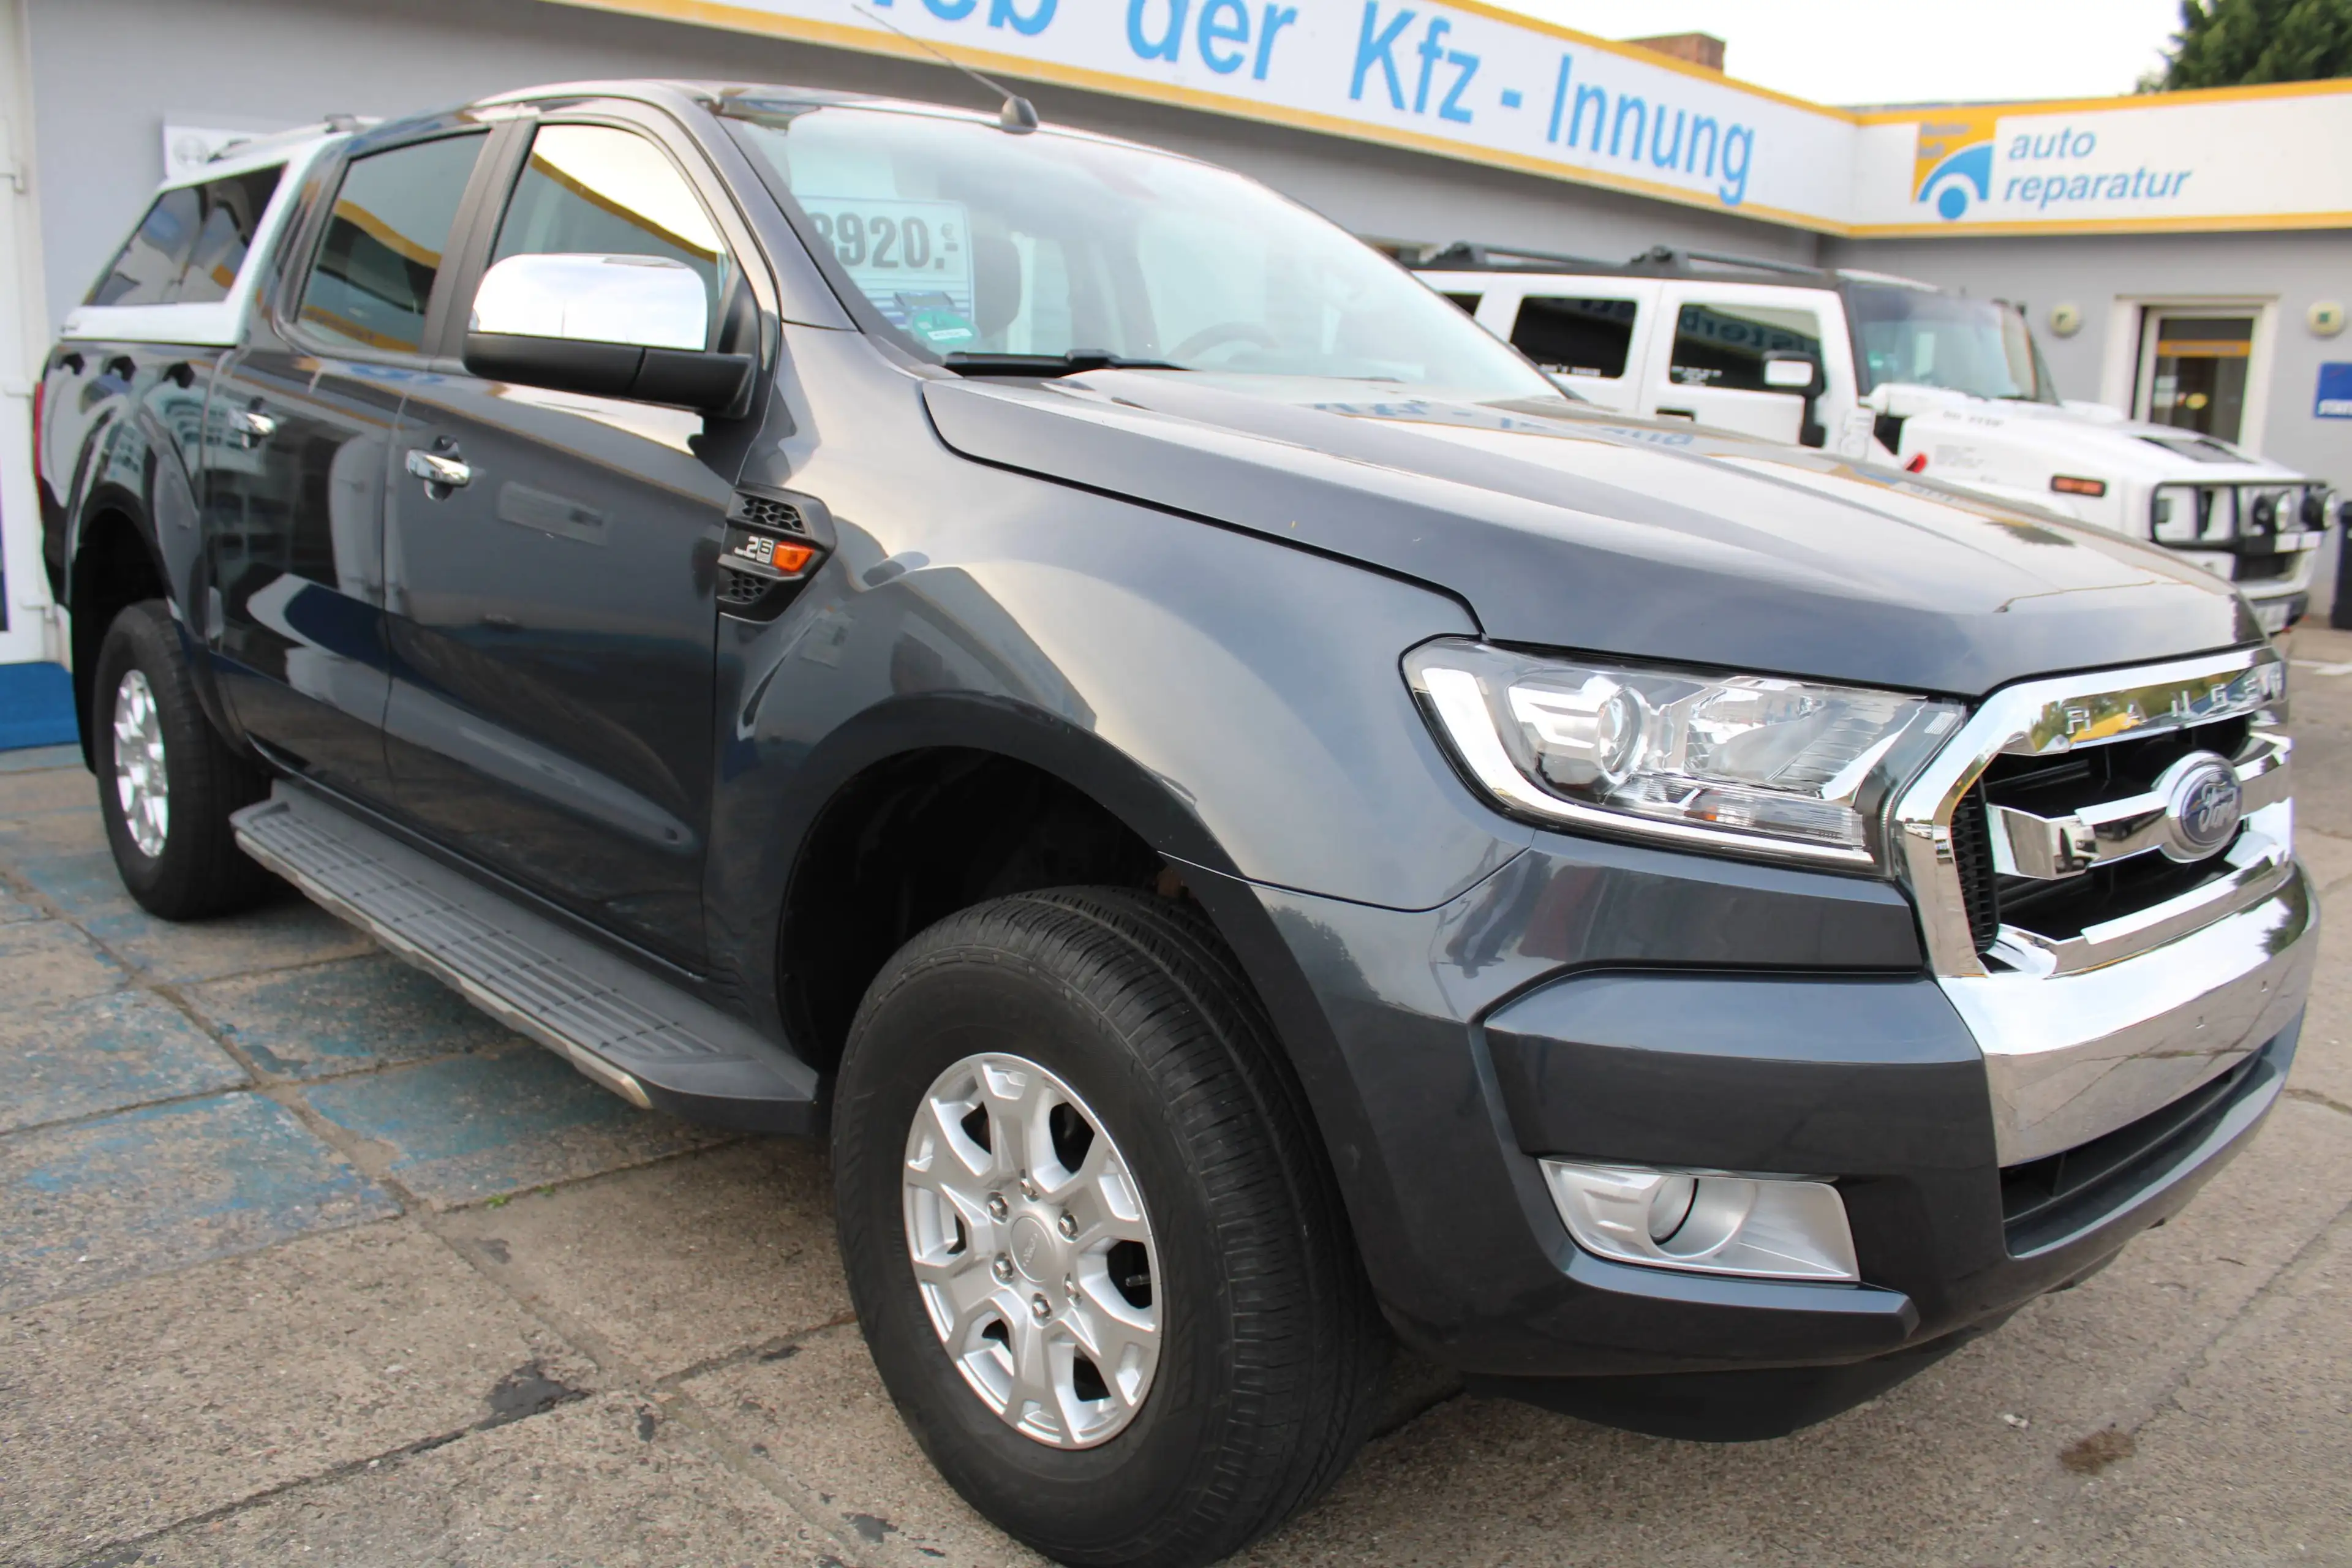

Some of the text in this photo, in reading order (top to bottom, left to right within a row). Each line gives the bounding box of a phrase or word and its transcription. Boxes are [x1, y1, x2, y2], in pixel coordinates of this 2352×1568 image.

[1126, 0, 1297, 80] der
[1349, 1, 1480, 124] Kfz
[1547, 53, 1754, 206] Innung
[2008, 127, 2097, 161] auto
[2003, 167, 2193, 210] reparatur
